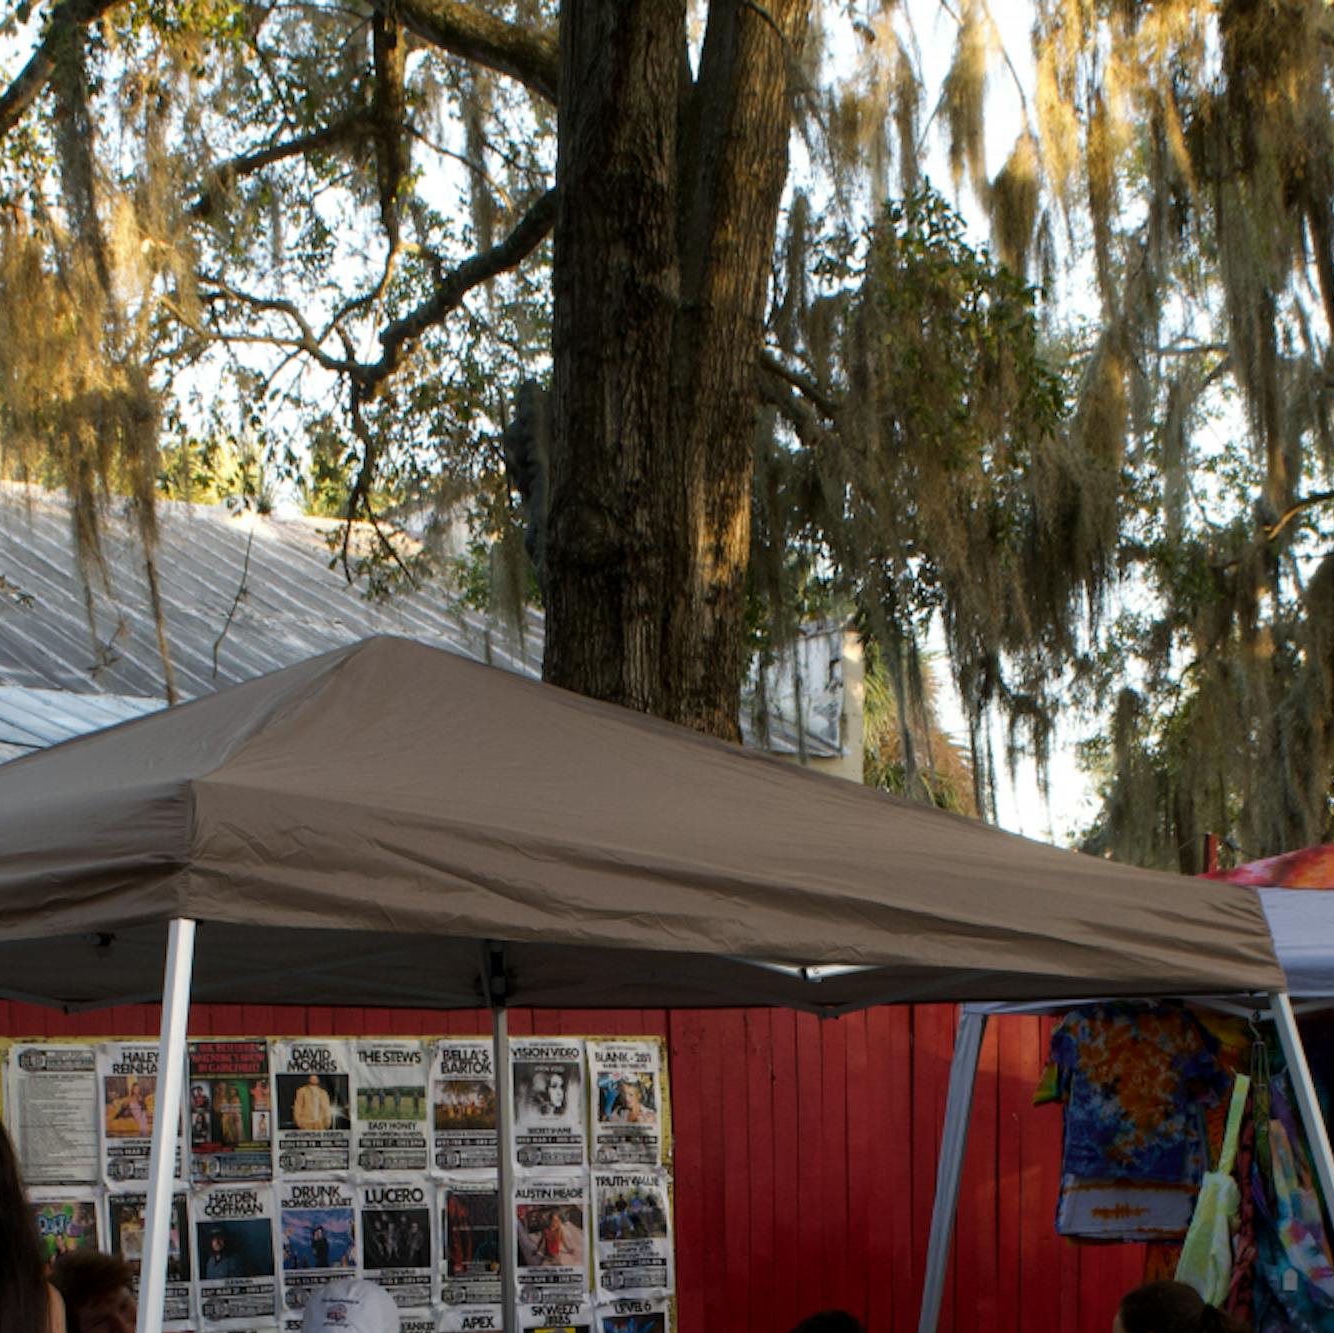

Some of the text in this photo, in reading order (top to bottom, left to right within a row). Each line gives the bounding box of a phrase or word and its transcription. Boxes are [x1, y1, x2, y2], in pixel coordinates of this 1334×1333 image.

[292, 1049, 331, 1062] DAVID
[358, 1051, 422, 1064] THE STEWS
[443, 1049, 490, 1062] BELLA'S
[551, 1047, 580, 1058] VIDEO
[113, 1063, 158, 1074] REINHA
[441, 1061, 492, 1074] BARTOK
[595, 1175, 628, 1187] TRUTH
[209, 1191, 258, 1205] HAYDEN
[292, 1186, 341, 1199] DRUNK
[365, 1188, 424, 1204] LUCERO
[515, 1188, 551, 1200] AUSTIN
[204, 1203, 264, 1217] COFFMAN
[461, 1316, 496, 1330] APEX
